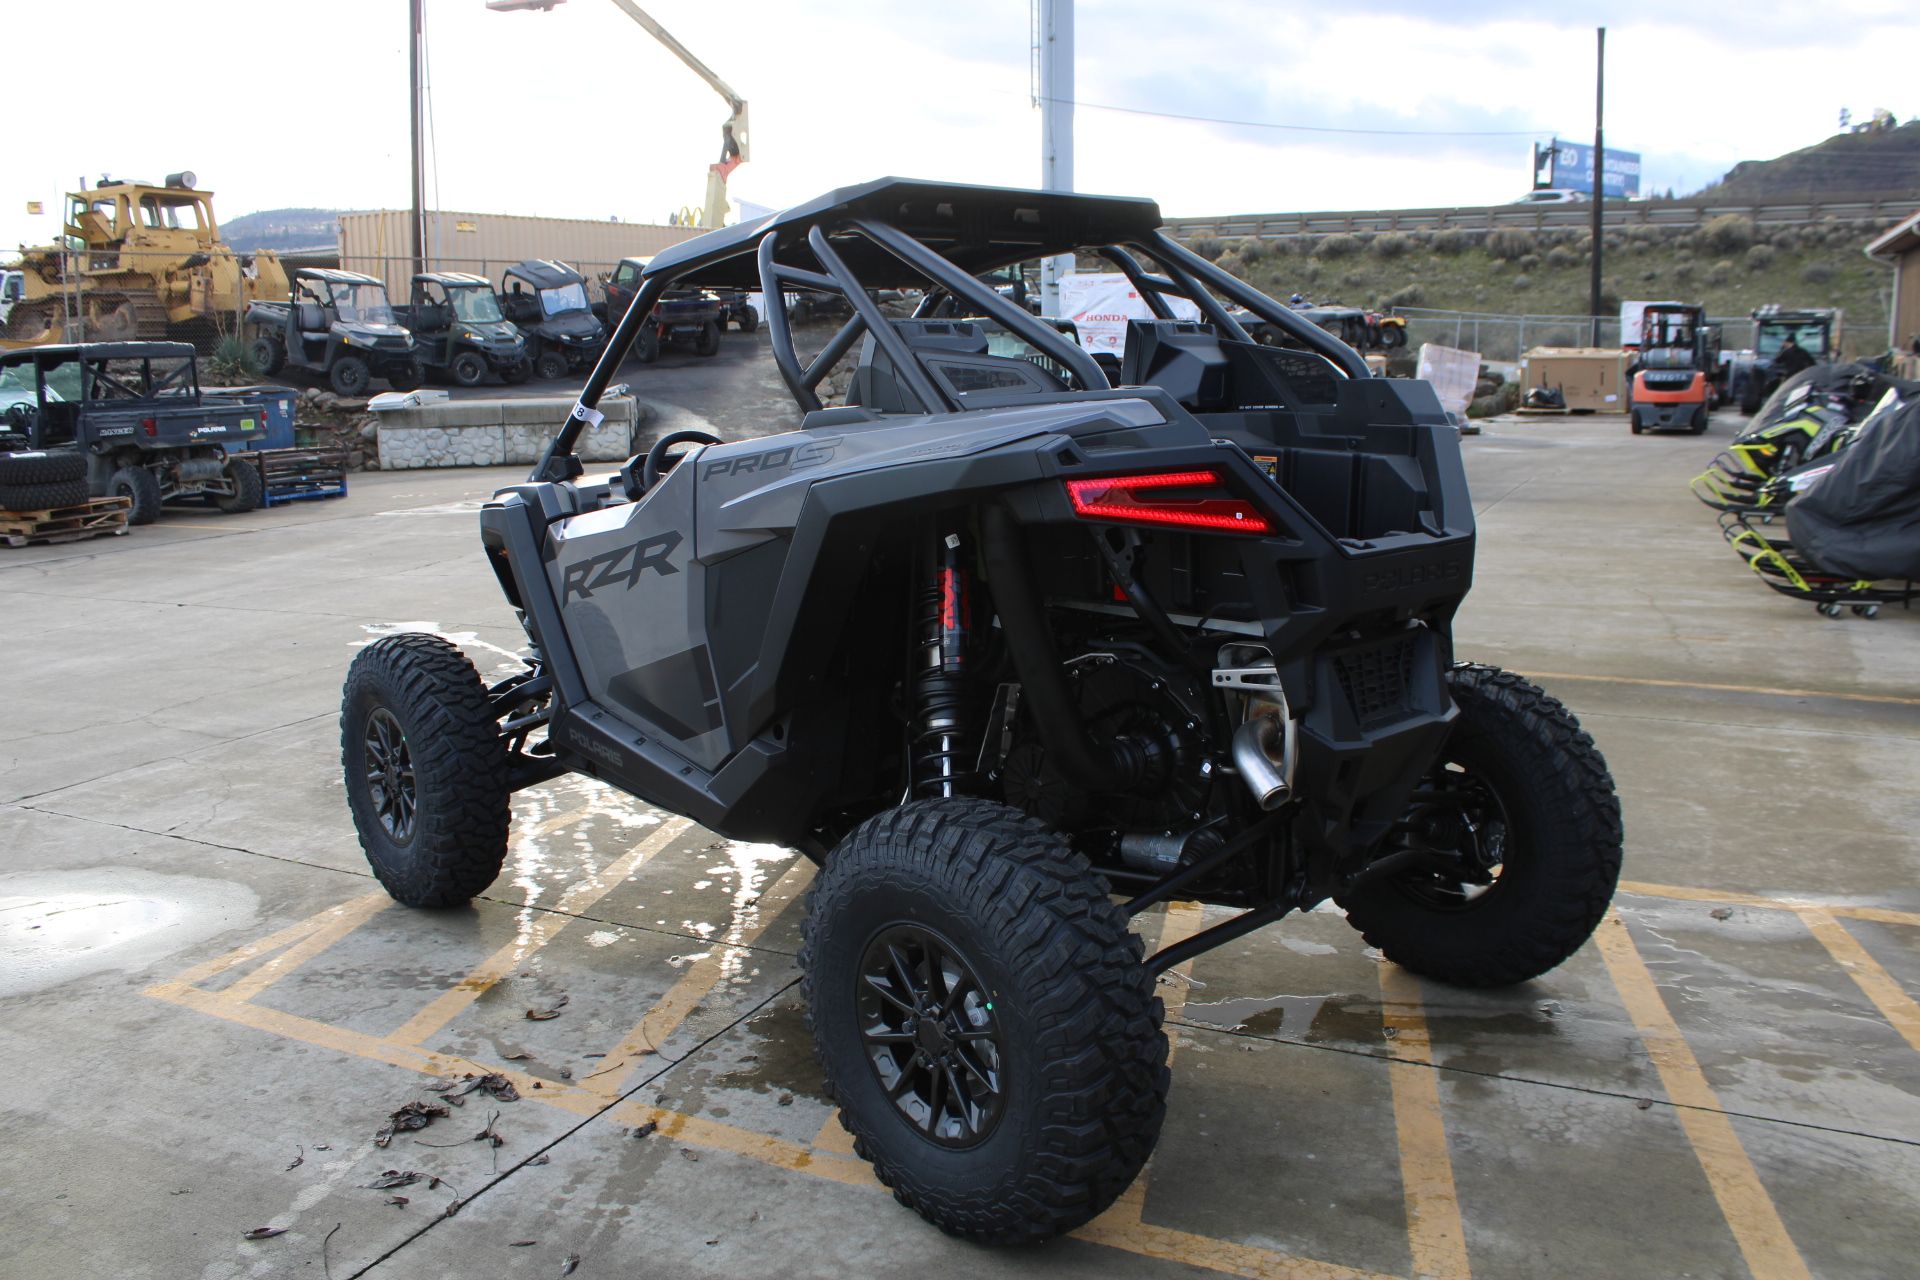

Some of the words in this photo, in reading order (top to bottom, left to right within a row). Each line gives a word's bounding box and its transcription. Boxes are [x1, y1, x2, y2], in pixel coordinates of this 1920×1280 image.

[1086, 313, 1128, 322] HONDA
[1649, 373, 1688, 381] TOYOTA
[197, 425, 227, 434] POLARIS
[562, 529, 684, 609] RZR
[568, 727, 624, 768] POLARIS
